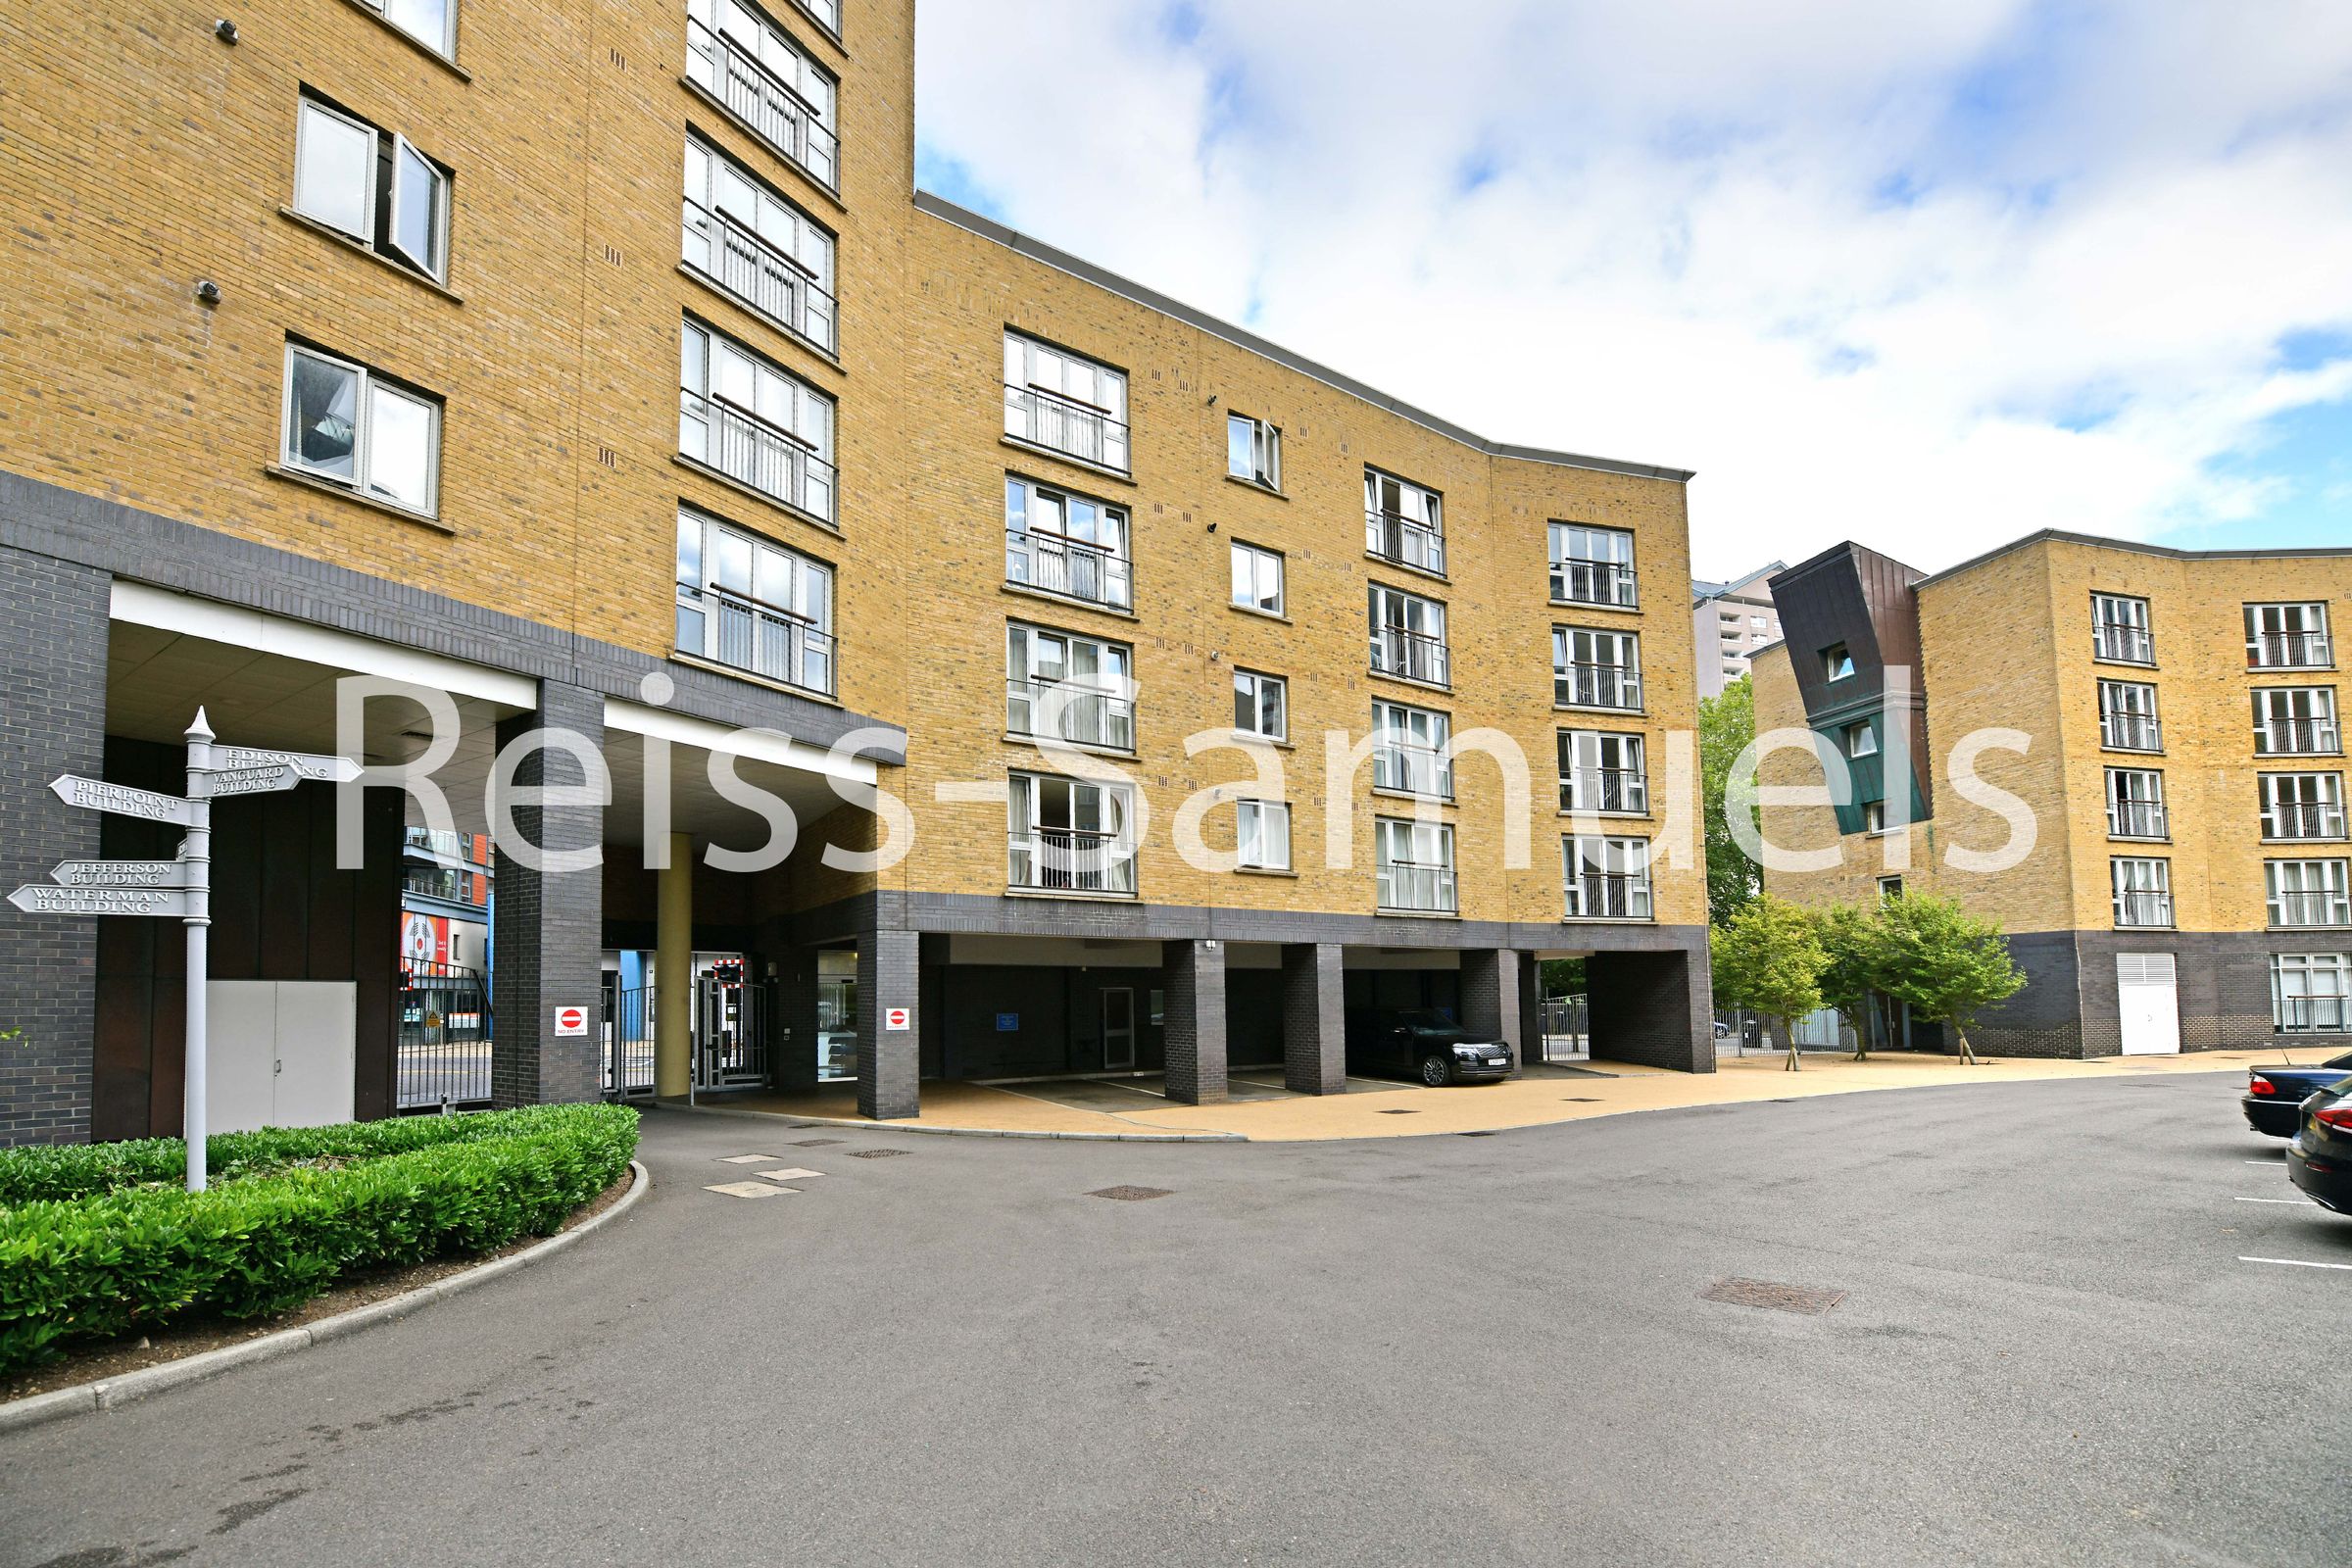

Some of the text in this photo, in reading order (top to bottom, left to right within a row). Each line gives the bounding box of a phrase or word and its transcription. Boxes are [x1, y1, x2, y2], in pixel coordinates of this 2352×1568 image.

[226, 750, 304, 765] EDISON
[214, 766, 284, 783] VANGUARD
[213, 778, 276, 794] BUILDING
[75, 781, 178, 810] PIERPOINT
[74, 793, 166, 819] BUILDING
[71, 863, 171, 874] JEFFERSON
[71, 874, 160, 885] BUILDING
[32, 888, 170, 903] WATERMAN
[35, 900, 152, 913] BUILDING
